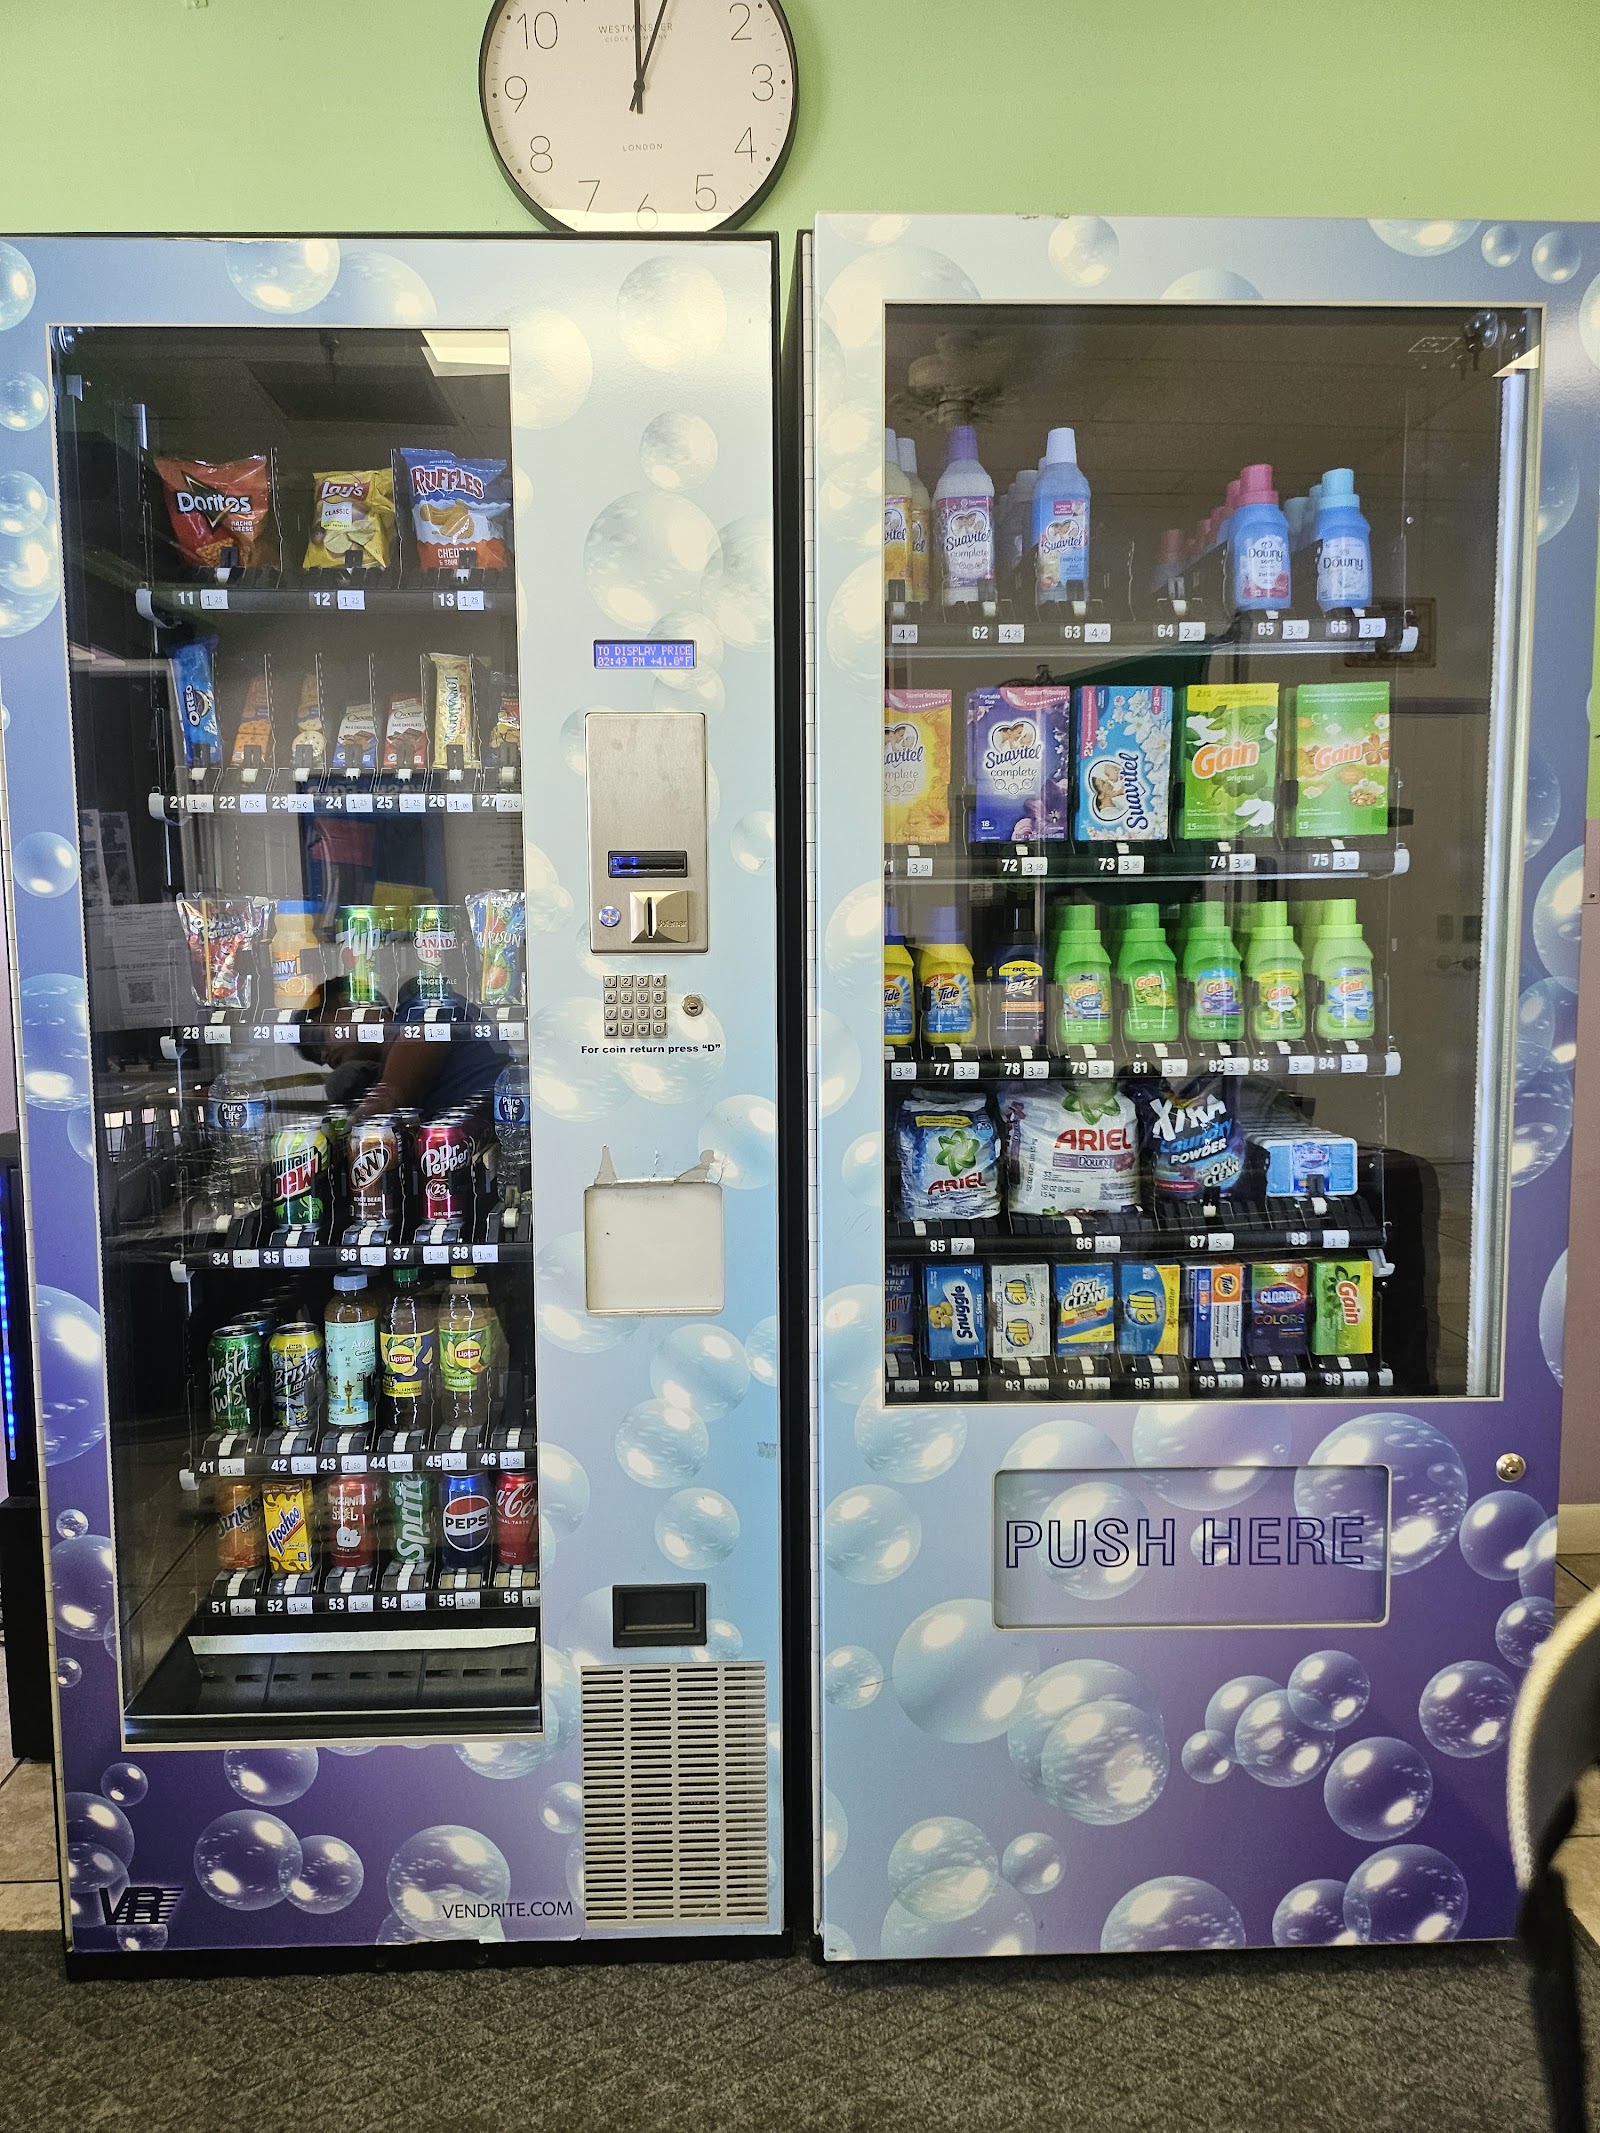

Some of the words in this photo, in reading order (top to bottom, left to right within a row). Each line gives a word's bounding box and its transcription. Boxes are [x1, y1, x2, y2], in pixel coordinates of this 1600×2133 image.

[598, 22, 673, 34] WESTMNSER
[729, 2, 752, 41] 2
[516, 11, 558, 50] 10
[751, 63, 774, 102] 3
[504, 76, 528, 114] 9
[622, 143, 663, 152] LONDON
[734, 126, 757, 164] 4
[530, 135, 553, 174] 8
[578, 180, 601, 216] 7
[695, 174, 717, 212] 5
[636, 193, 659, 231] 6
[410, 465, 485, 500] RUFFLES
[321, 482, 364, 500] Lay's
[177, 492, 251, 514] Doritos
[325, 508, 349, 516] CLASSIC
[946, 529, 991, 552] Suavitel
[1042, 535, 1083, 554] Suavitel
[1248, 546, 1284, 563] Downy
[1323, 555, 1363, 571] Downy
[178, 591, 194, 605] 11
[314, 592, 331, 606] 12
[438, 592, 455, 607] 13
[972, 626, 989, 640] 62
[1064, 625, 1081, 639] 63
[1157, 624, 1174, 637] 64
[1257, 622, 1275, 636] 65
[1330, 620, 1347, 634] 66
[598, 646, 609, 655] TO
[615, 646, 657, 655] DISPLAY
[662, 646, 692, 655] PRICE
[597, 656, 627, 666] 02:49
[632, 656, 645, 666] PM
[185, 684, 201, 726] OREO
[985, 745, 1041, 769] Suavitel
[1192, 741, 1259, 778] Gain
[1314, 744, 1363, 770] Gain
[990, 767, 1037, 780] complete
[1226, 773, 1255, 782] original
[1126, 752, 1149, 830] Suavitel
[170, 796, 185, 809] 21
[219, 796, 236, 809] 22
[272, 796, 288, 809] 23
[325, 796, 343, 809] 24
[376, 796, 393, 809] 25
[429, 795, 446, 807] 26
[481, 795, 497, 807] 27
[1001, 859, 1018, 872] 72
[1098, 858, 1115, 871] 73
[1209, 855, 1227, 869] 74
[1312, 853, 1329, 867] 75
[414, 938, 458, 949] CANADA
[446, 978, 457, 986] ALE
[1136, 975, 1161, 989] Gain
[1205, 980, 1230, 993] Gain
[1339, 979, 1365, 993] Gain
[937, 986, 960, 1001] Tide
[1071, 985, 1099, 999] Gain
[1268, 986, 1293, 1000] Gain
[183, 1026, 200, 1039] 28
[253, 1026, 270, 1039] 29
[334, 1026, 351, 1039] 31
[404, 1026, 421, 1039] 32
[474, 1025, 492, 1038] 33
[581, 1046, 599, 1054] For
[602, 1046, 626, 1054] coin
[630, 1045, 665, 1053] return
[668, 1046, 699, 1055] press
[934, 1063, 950, 1076] 77
[1004, 1063, 1021, 1075] 78
[1070, 1062, 1087, 1074] 79
[1132, 1062, 1148, 1074] 81
[1209, 1060, 1224, 1072] 82
[1253, 1059, 1269, 1071] 83
[1318, 1057, 1335, 1070] 84
[503, 1097, 520, 1105] Pure
[224, 1112, 240, 1121] Life
[1054, 1128, 1132, 1151] ARIEL
[439, 1144, 460, 1163] Dr
[1170, 1138, 1228, 1164] POWDER
[422, 1147, 469, 1177] Pepper
[1078, 1156, 1113, 1168] Downy
[1203, 1160, 1240, 1187] CLEAN
[434, 1185, 446, 1194] 23
[927, 1172, 987, 1195] ARIEL
[1076, 1237, 1092, 1250] 86
[1189, 1235, 1206, 1248] 87
[1290, 1232, 1308, 1245] 88
[452, 1246, 469, 1259] 38
[930, 1240, 945, 1252] 85
[212, 1253, 229, 1265] 34
[263, 1251, 280, 1264] 35
[340, 1248, 357, 1261] 36
[393, 1247, 409, 1260] 37
[1070, 1280, 1097, 1297] OXI
[1063, 1288, 1107, 1311] CLEAN
[1337, 1281, 1361, 1325] Gain
[951, 1285, 973, 1340] Snuggle
[1254, 1314, 1305, 1325] COLORS
[391, 1356, 411, 1365] Lipton
[457, 1350, 478, 1360] Lipton
[934, 1380, 950, 1392] 92
[1005, 1379, 1021, 1391] 93
[1068, 1379, 1084, 1391] 94
[1135, 1377, 1150, 1389] 95
[1199, 1376, 1216, 1388] 96
[1261, 1375, 1277, 1387] 97
[1324, 1373, 1341, 1386] 98
[271, 1459, 288, 1472] 42
[320, 1458, 337, 1470] 43
[370, 1456, 386, 1469] 44
[426, 1455, 442, 1467] 45
[480, 1453, 496, 1465] 46
[199, 1461, 214, 1473] 41
[395, 1473, 430, 1562] Sprite
[446, 1513, 488, 1530] PEPS
[1006, 1518, 1176, 1568] PUSH
[1202, 1516, 1364, 1566] HERE
[328, 1598, 344, 1610] 53
[381, 1597, 397, 1609] 54
[439, 1595, 454, 1607] 55
[504, 1591, 519, 1604] 56
[211, 1601, 226, 1613] 51
[267, 1600, 283, 1612] 52
[442, 1901, 573, 1919] VENDRITE.COM
